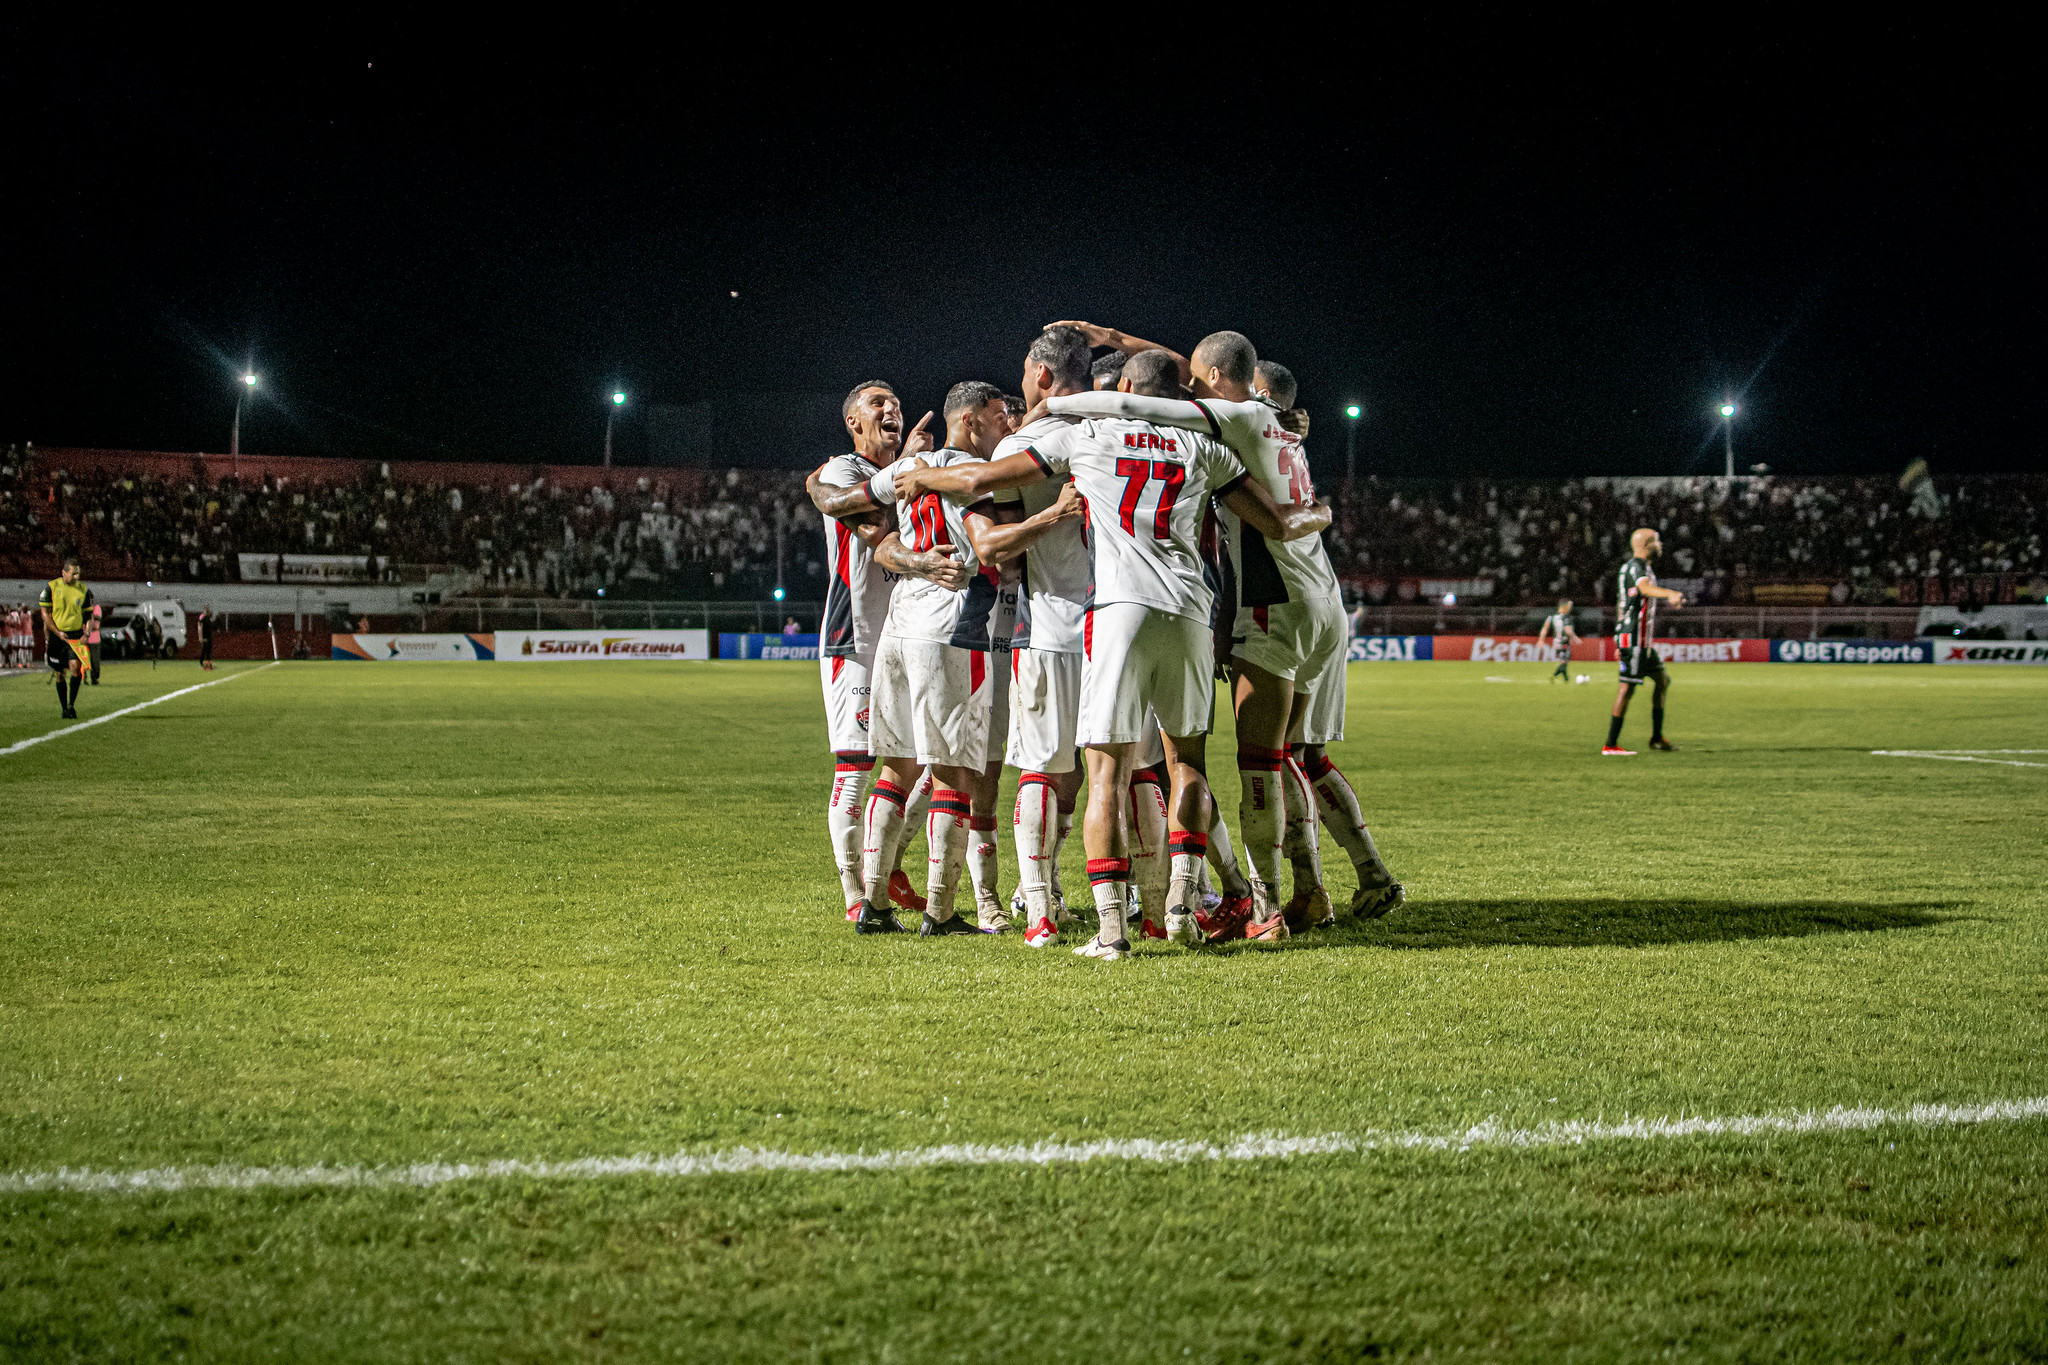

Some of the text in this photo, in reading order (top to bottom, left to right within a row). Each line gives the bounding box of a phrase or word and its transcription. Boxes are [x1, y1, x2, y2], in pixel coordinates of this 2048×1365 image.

[1124, 432, 1177, 452] NERIS
[1114, 456, 1187, 540] 77
[999, 588, 1019, 604] fa
[537, 637, 685, 656] SANTA TEREZINHA
[992, 643, 1012, 653] PIS
[1653, 640, 1742, 662] PERBET
[1803, 641, 1923, 664] BETesporte
